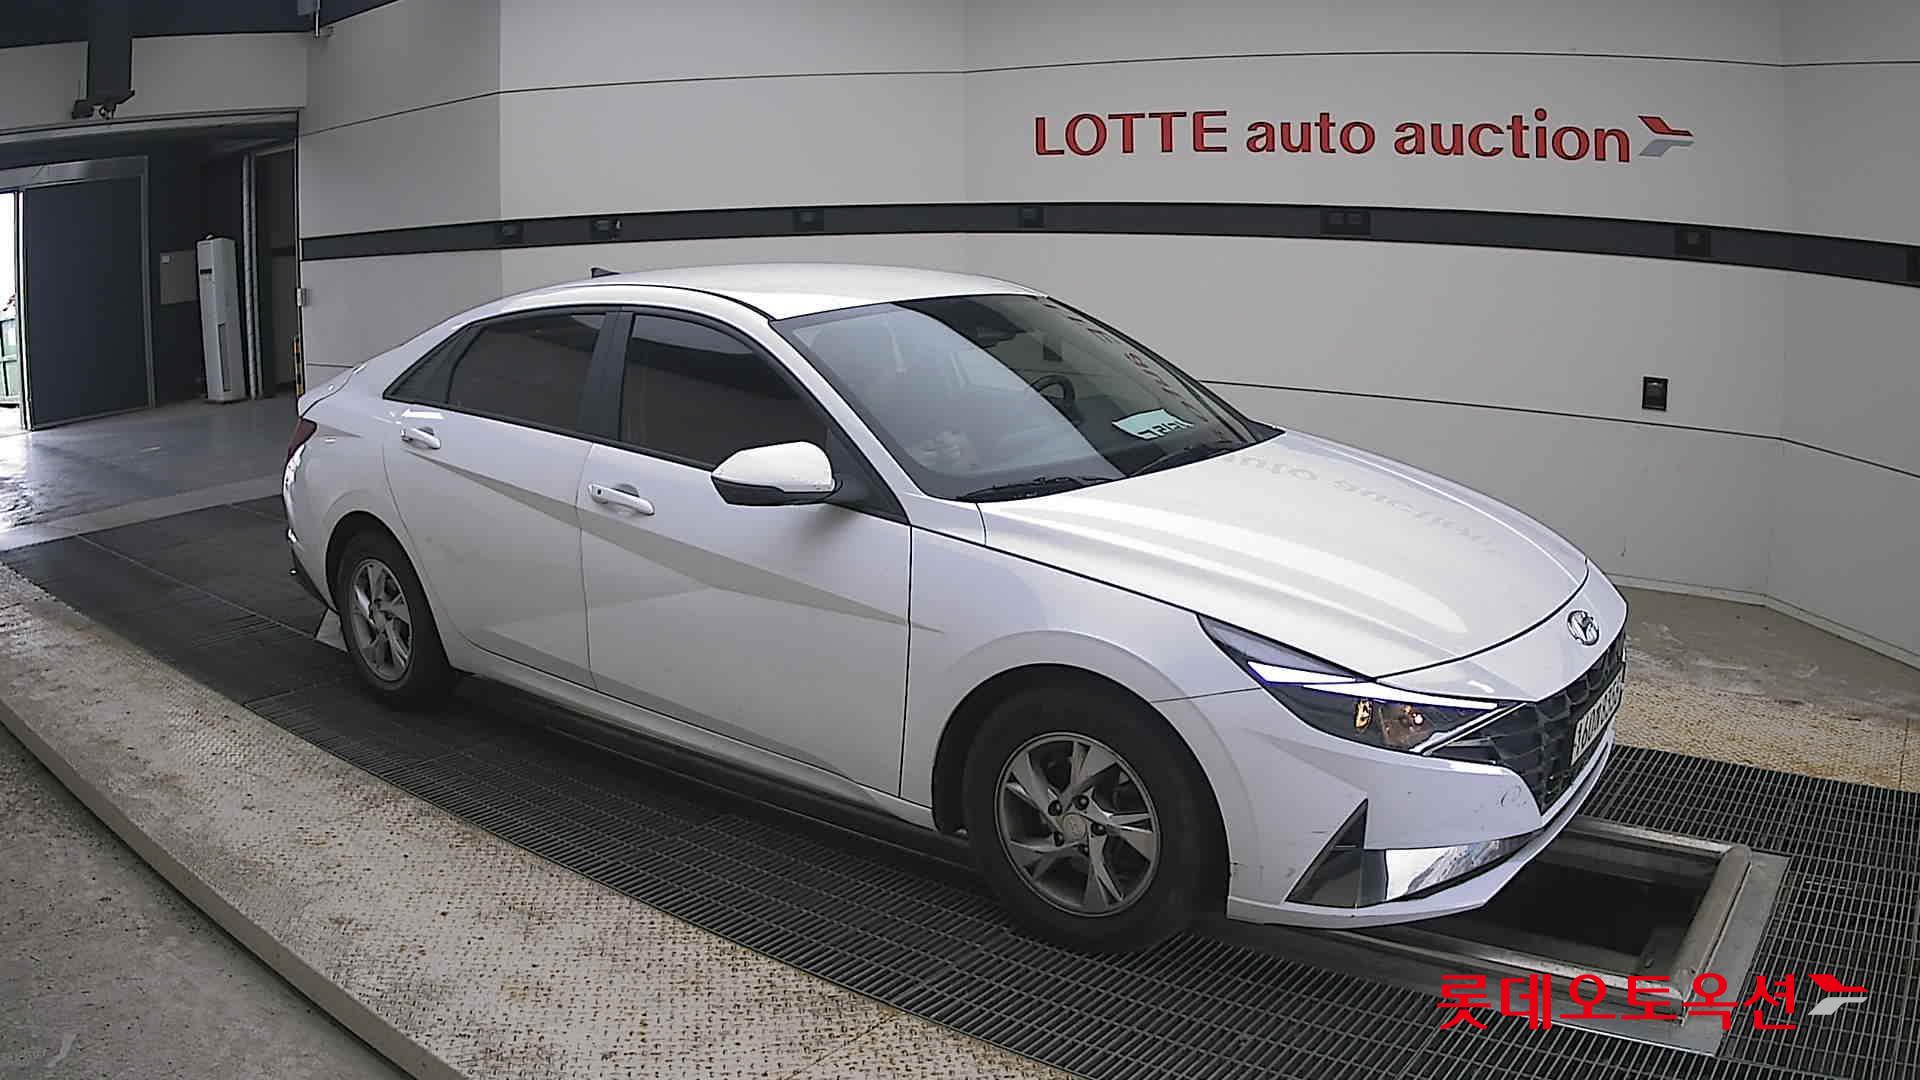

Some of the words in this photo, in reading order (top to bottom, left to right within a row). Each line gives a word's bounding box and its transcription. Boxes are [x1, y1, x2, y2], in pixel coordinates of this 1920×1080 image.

[1035, 110, 1228, 156] LOTTE
[1246, 112, 1376, 154] auto
[1394, 108, 1631, 163] auction
